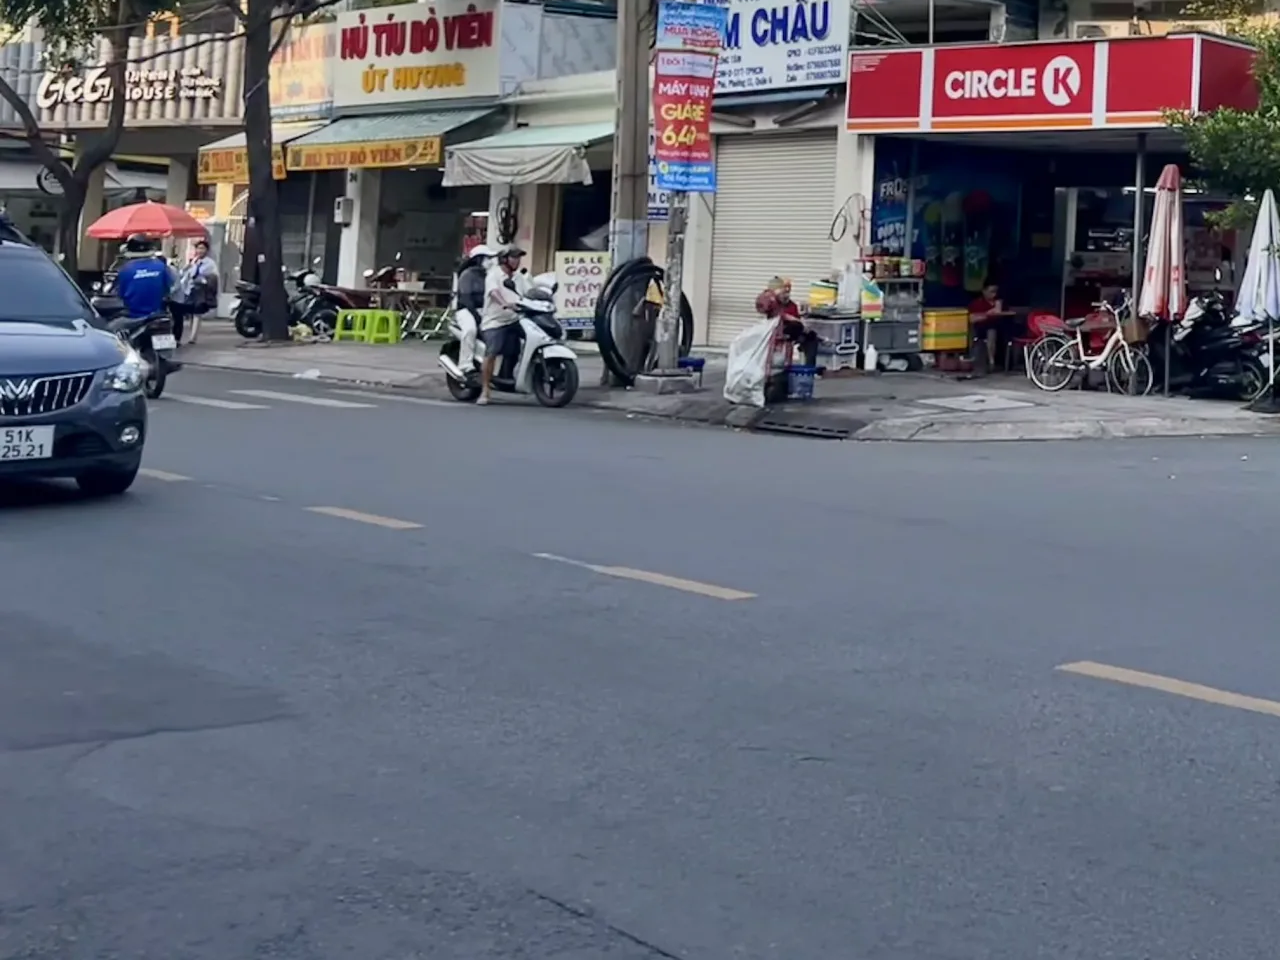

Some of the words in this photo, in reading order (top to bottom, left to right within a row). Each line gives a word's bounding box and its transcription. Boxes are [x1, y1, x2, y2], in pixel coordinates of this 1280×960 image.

[341, 13, 369, 60] HỦ
[373, 13, 407, 58] TÍU
[410, 7, 440, 54] BÒ
[443, 3, 494, 50] VIÊN
[362, 64, 389, 93] ÚT
[393, 63, 466, 90] HƯƠNG
[658, 80, 688, 96] MÁY
[944, 68, 1037, 100] CIRCLE
[4, 429, 35, 443] 51K
[1, 443, 45, 458] 25.21
